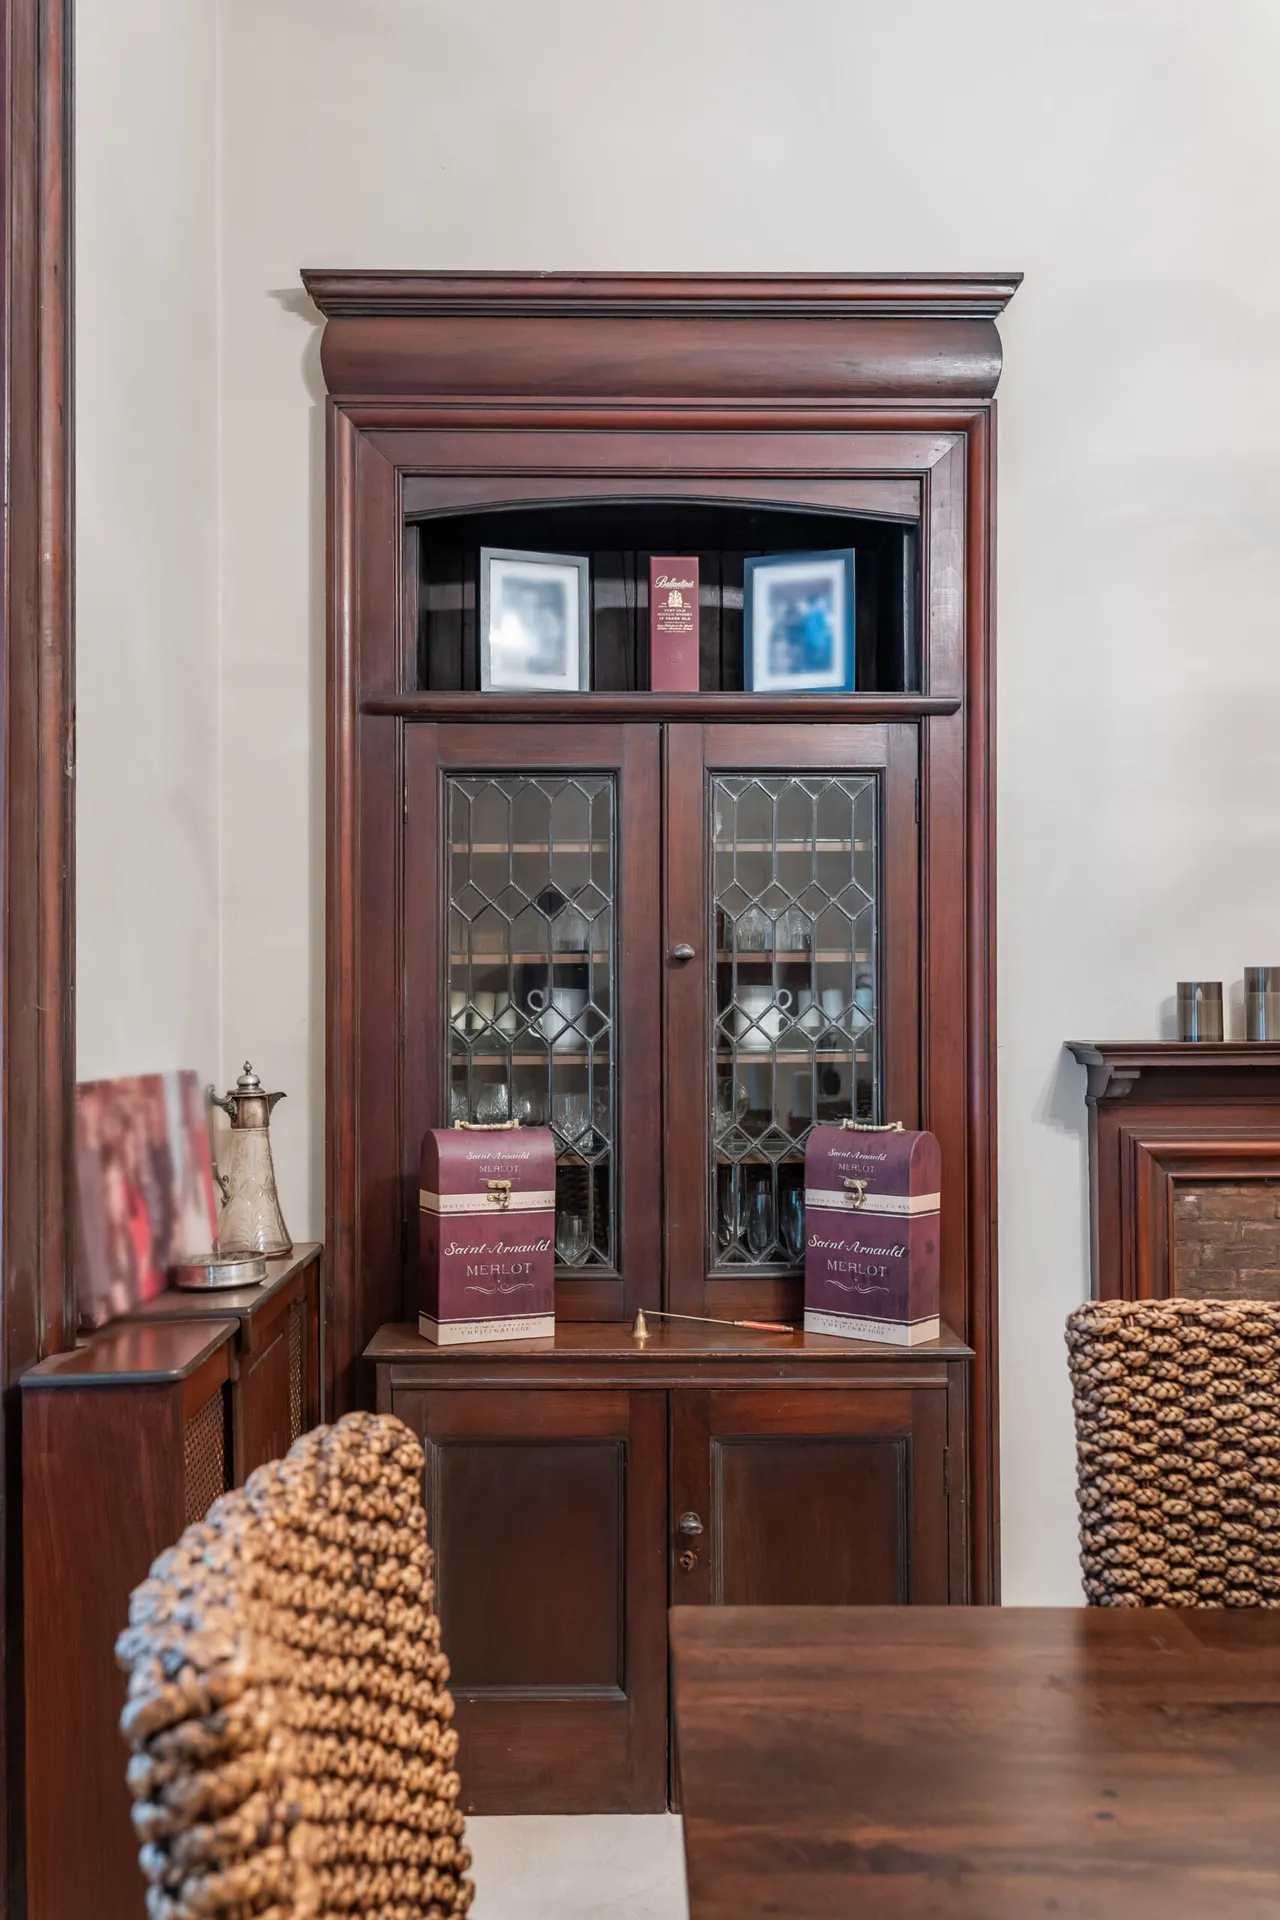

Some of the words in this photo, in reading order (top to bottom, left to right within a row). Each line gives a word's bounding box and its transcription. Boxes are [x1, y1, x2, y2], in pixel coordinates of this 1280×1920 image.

[479, 1164, 520, 1173] MERLOT
[838, 1163, 875, 1173] MERLOT
[466, 1262, 532, 1277] MERLOT
[827, 1259, 888, 1277] MERLOT
